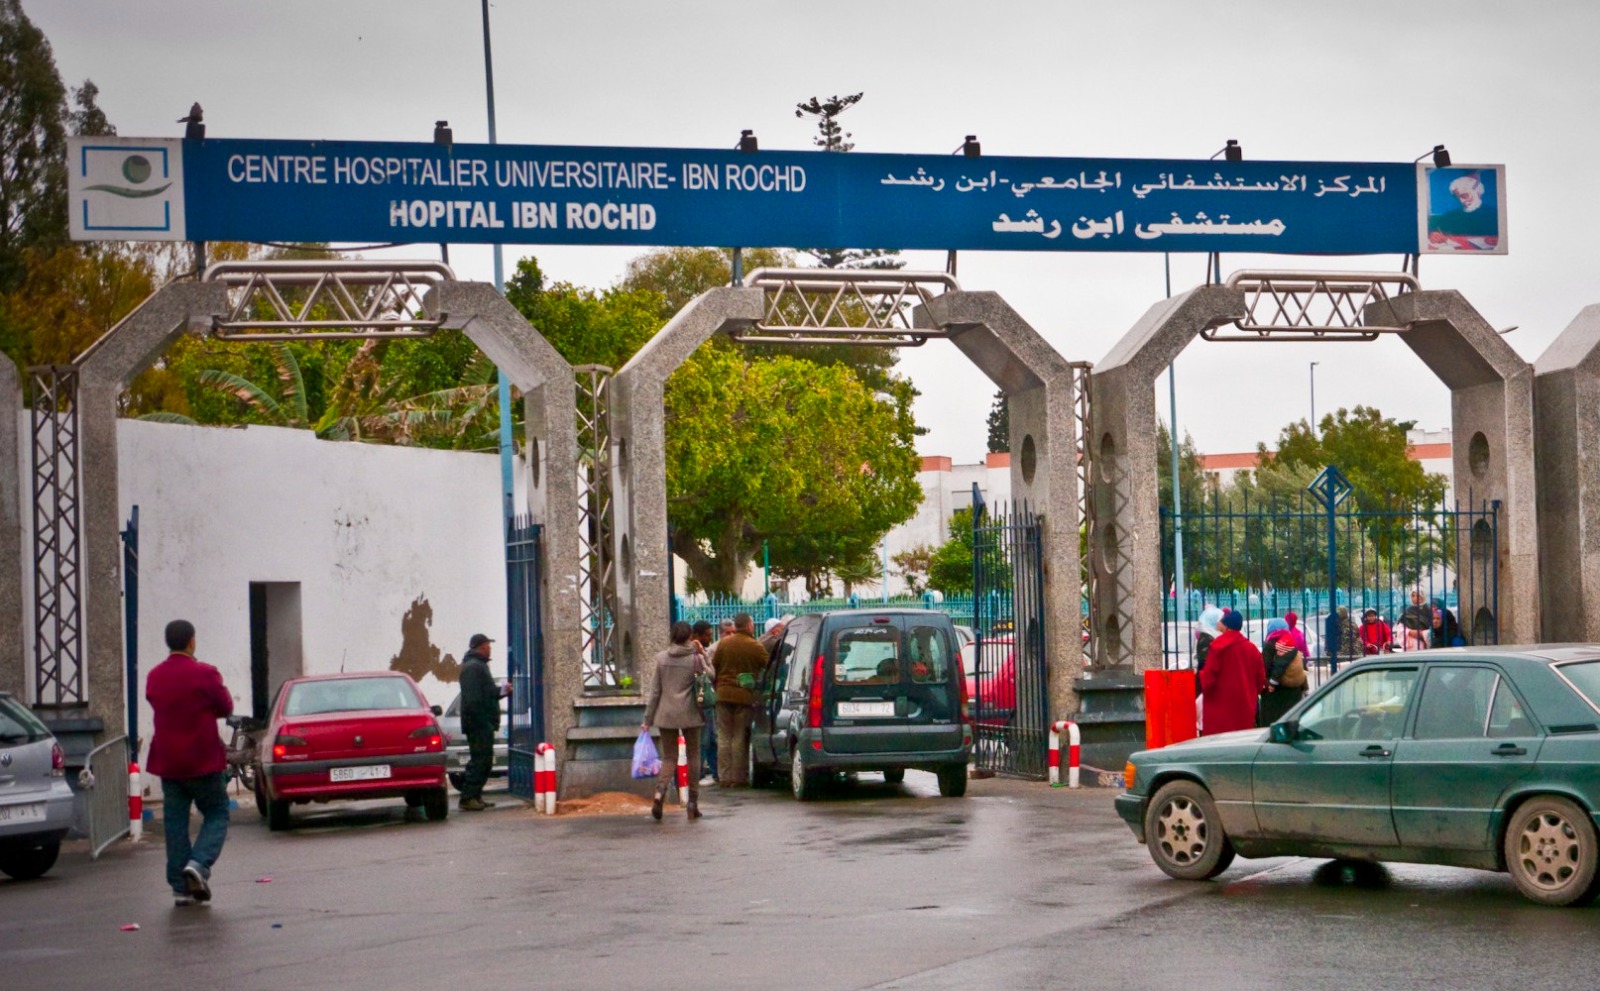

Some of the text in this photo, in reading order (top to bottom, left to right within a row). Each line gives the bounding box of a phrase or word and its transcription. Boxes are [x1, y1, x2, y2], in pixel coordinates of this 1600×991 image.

[227, 154, 807, 192] CENTRE HOSPITALIER UNIVERSITAIRE- IBN ROCHD
[880, 167, 946, 191] رشد
[1132, 172, 1307, 199] الاستشفائي
[1313, 175, 1386, 198] المركز
[389, 199, 657, 230] HOPITAL IBN ROCHD
[992, 208, 1287, 240] مستشفى ابن رشد
